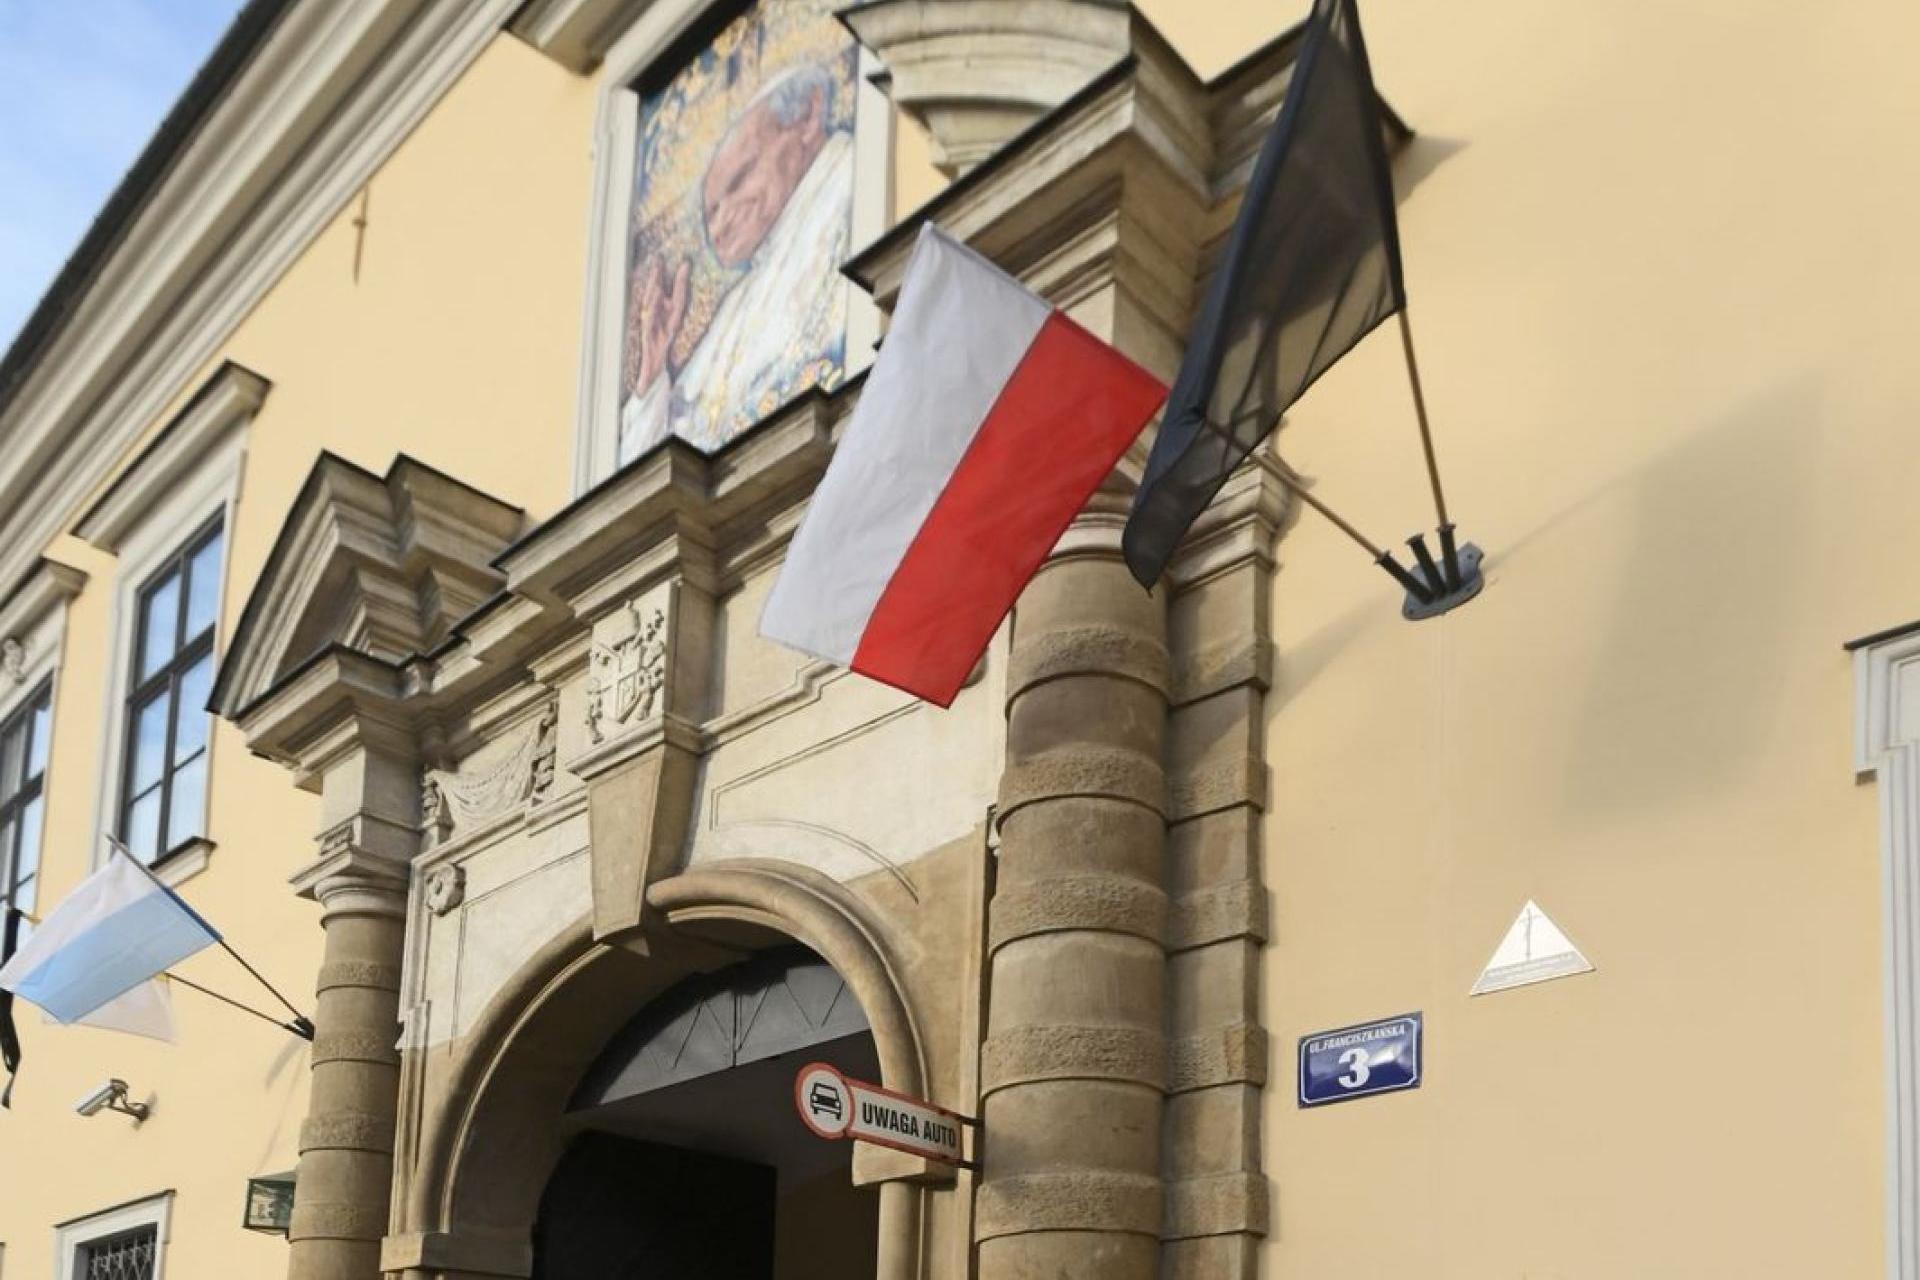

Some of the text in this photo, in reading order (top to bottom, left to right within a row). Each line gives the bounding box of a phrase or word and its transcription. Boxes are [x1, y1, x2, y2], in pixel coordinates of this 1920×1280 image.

[1338, 1047, 1370, 1088] 3
[862, 1102, 957, 1149] UWAGA AUTO
